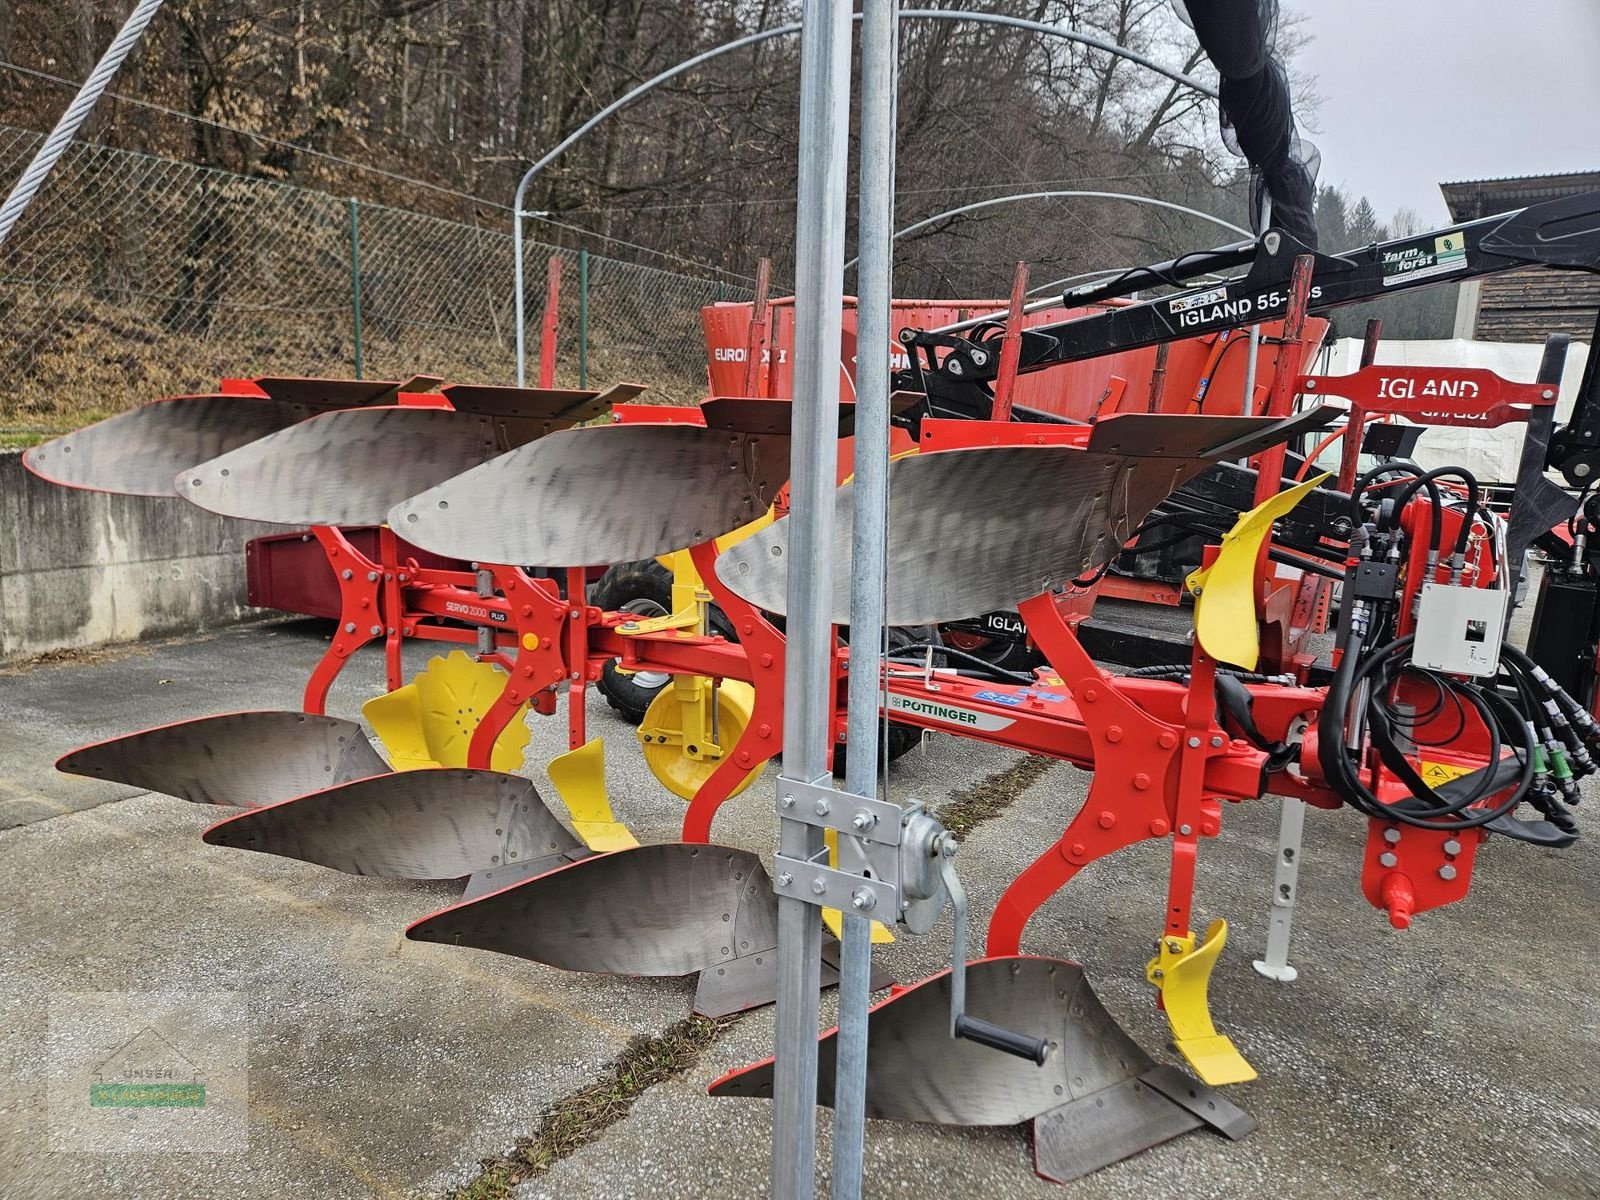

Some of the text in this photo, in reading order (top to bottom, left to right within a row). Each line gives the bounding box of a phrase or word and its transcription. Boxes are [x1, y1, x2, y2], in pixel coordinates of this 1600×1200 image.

[1383, 248, 1418, 262] farm
[1399, 255, 1433, 272] forst
[1180, 299, 1252, 327] IGLAND
[1257, 286, 1322, 310] 55-s
[446, 602, 468, 613] SERVO
[469, 606, 486, 617] 2000
